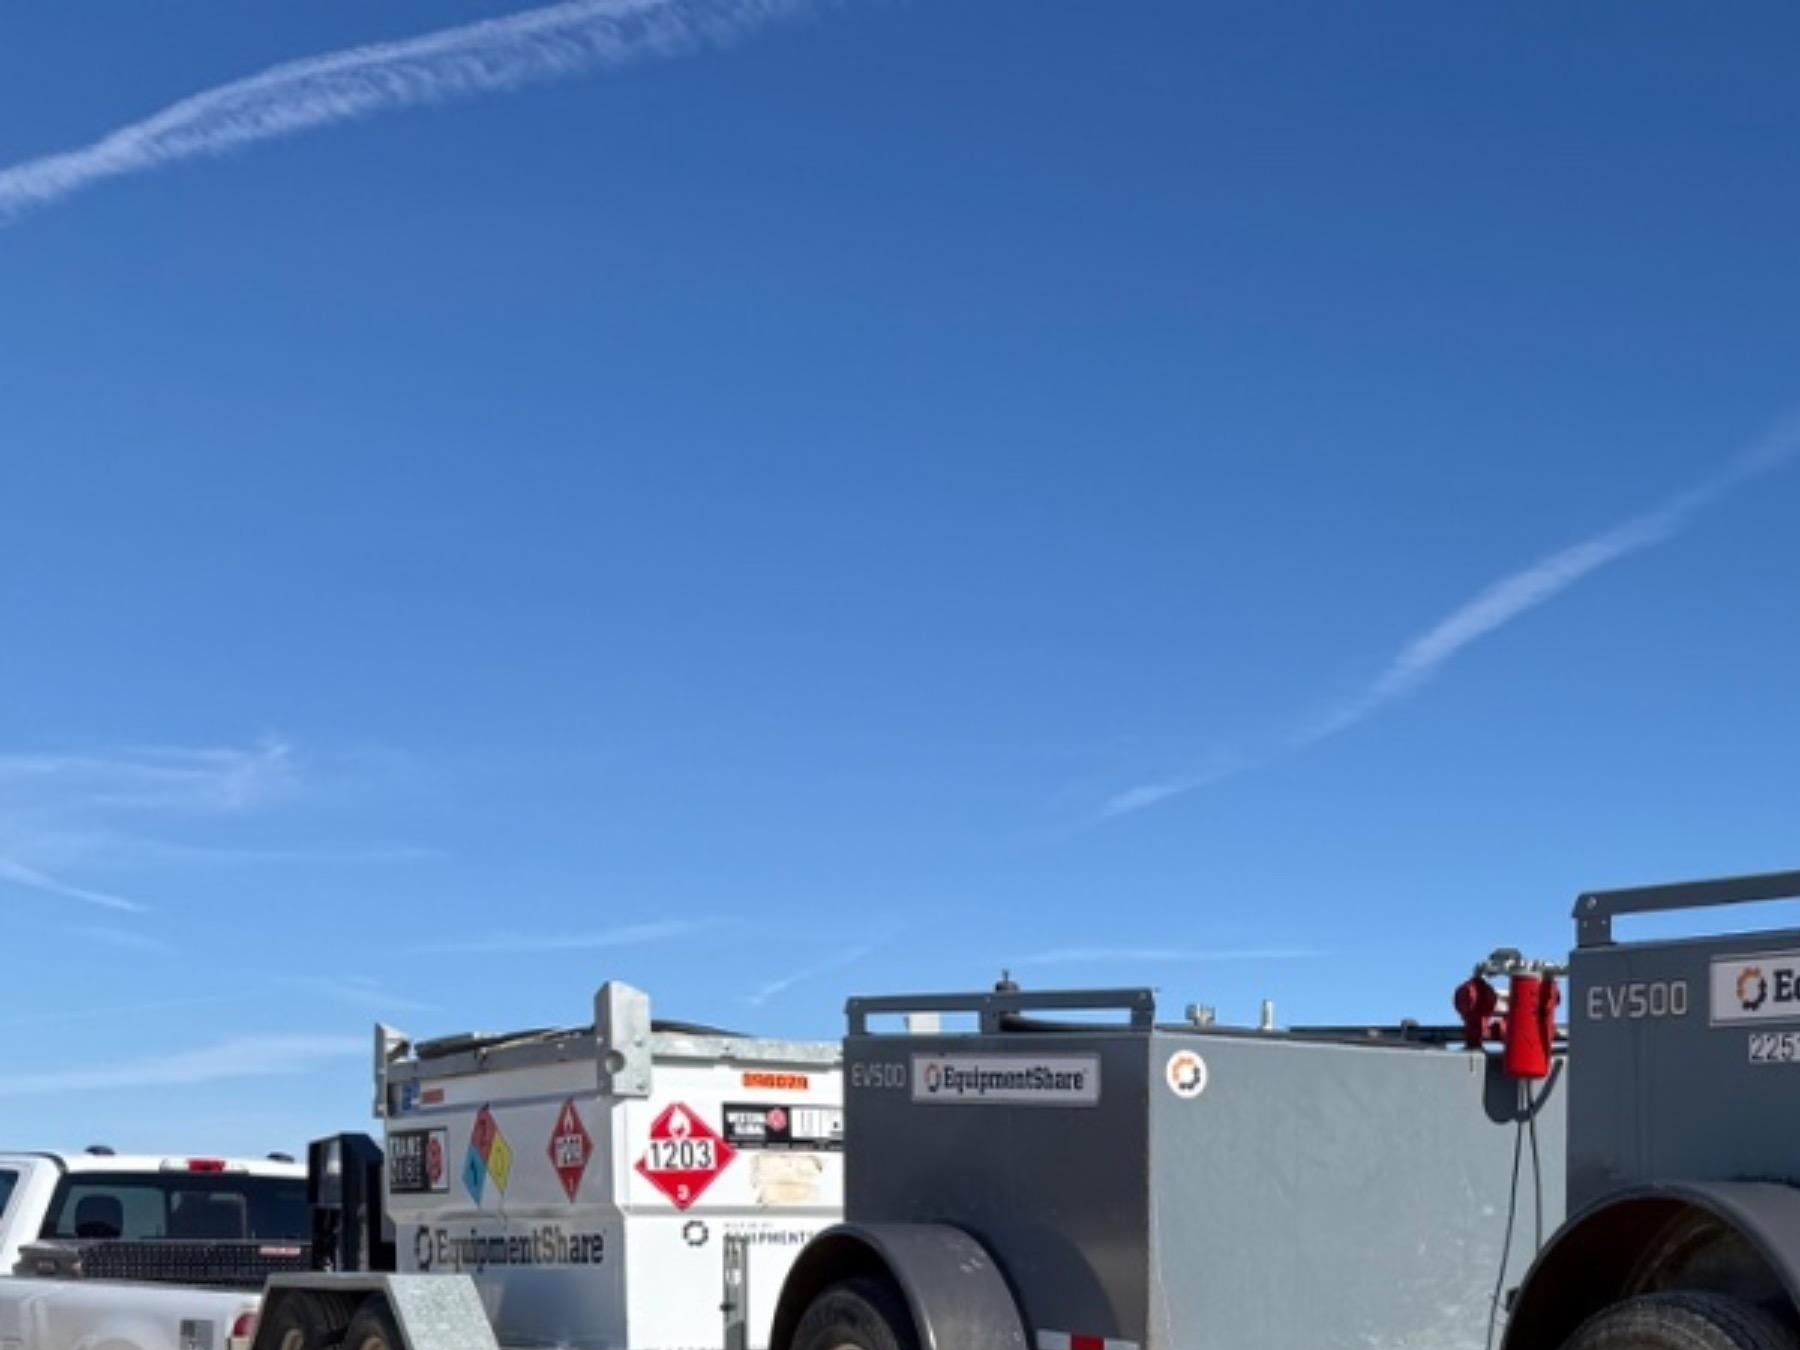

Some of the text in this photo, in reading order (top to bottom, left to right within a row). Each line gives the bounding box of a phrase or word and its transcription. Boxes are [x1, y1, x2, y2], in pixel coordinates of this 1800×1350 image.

[1587, 982, 1688, 1020] EV500
[851, 1062, 907, 1088] EV500
[944, 1064, 1084, 1095] EquipmentShare
[650, 1140, 712, 1169] 1203
[677, 1184, 690, 1200] 3
[436, 1225, 604, 1273] EquipmentShare
